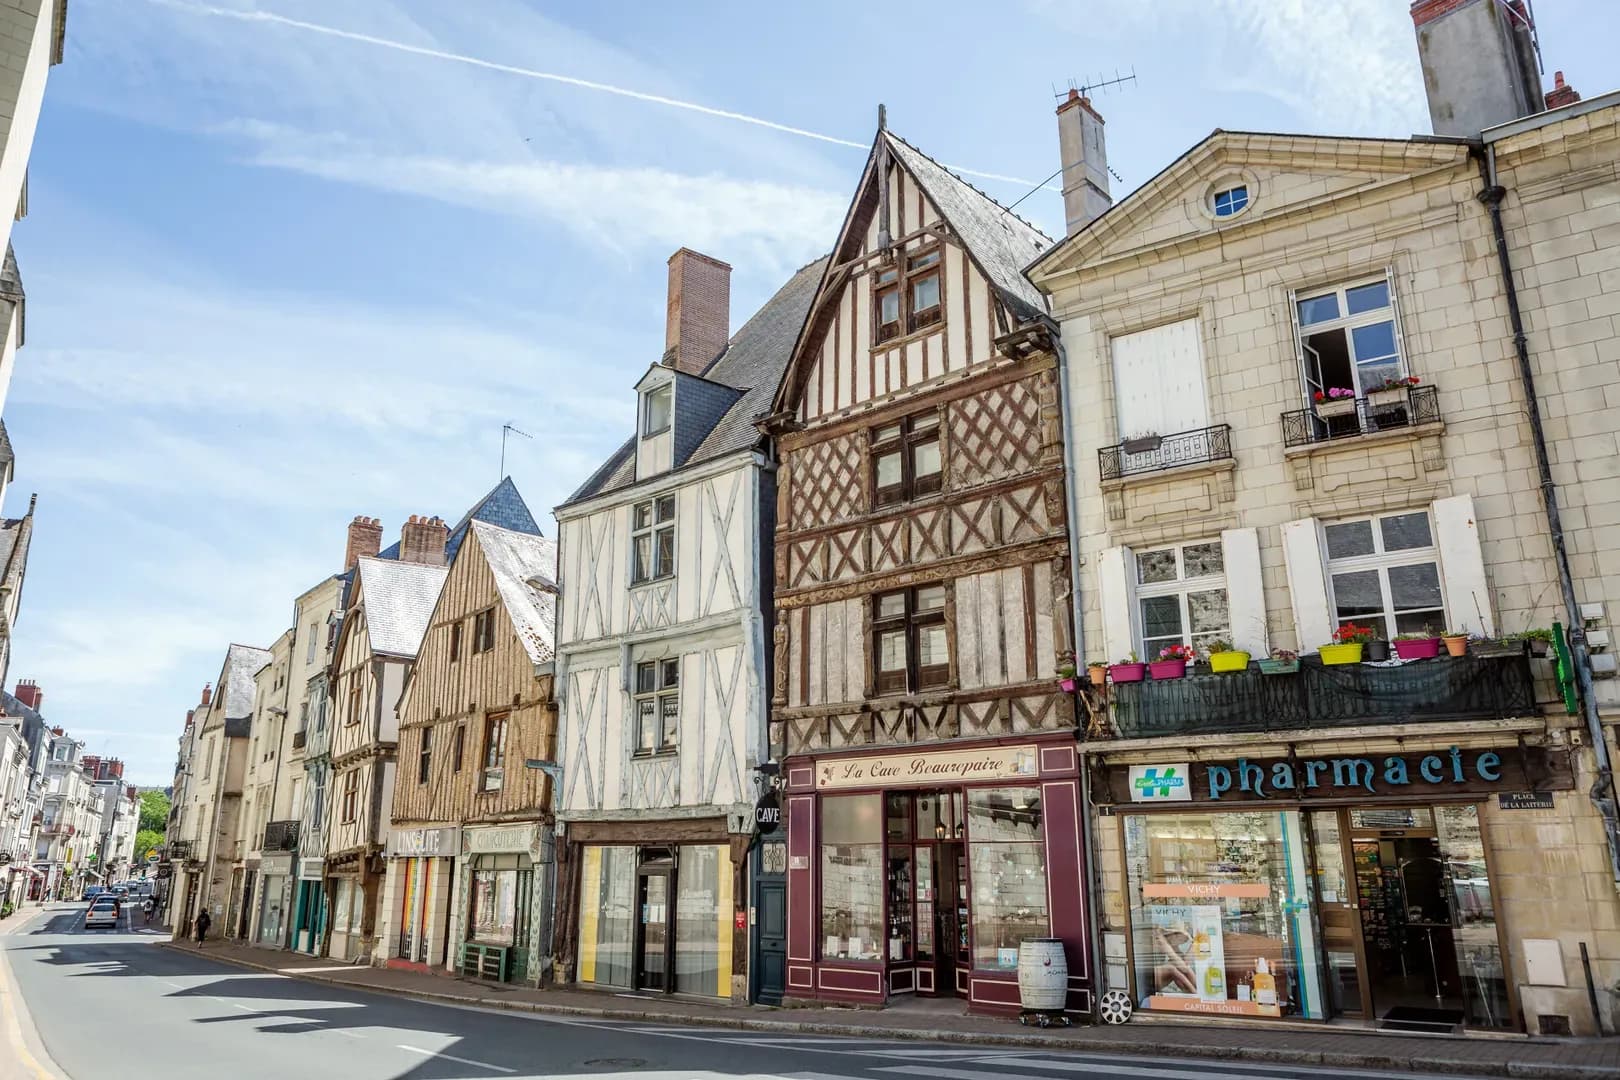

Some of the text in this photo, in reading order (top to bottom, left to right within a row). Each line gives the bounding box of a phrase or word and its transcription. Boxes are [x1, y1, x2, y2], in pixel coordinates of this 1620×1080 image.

[842, 757, 1004, 779] La Cave Beaurepaire
[1207, 745, 1501, 800] pharmacie
[756, 807, 780, 823] CAVE
[1187, 885, 1221, 894] VICHY
[1155, 908, 1188, 917] VICHY
[1184, 1002, 1243, 1013] CAPITAL SOLEIL
